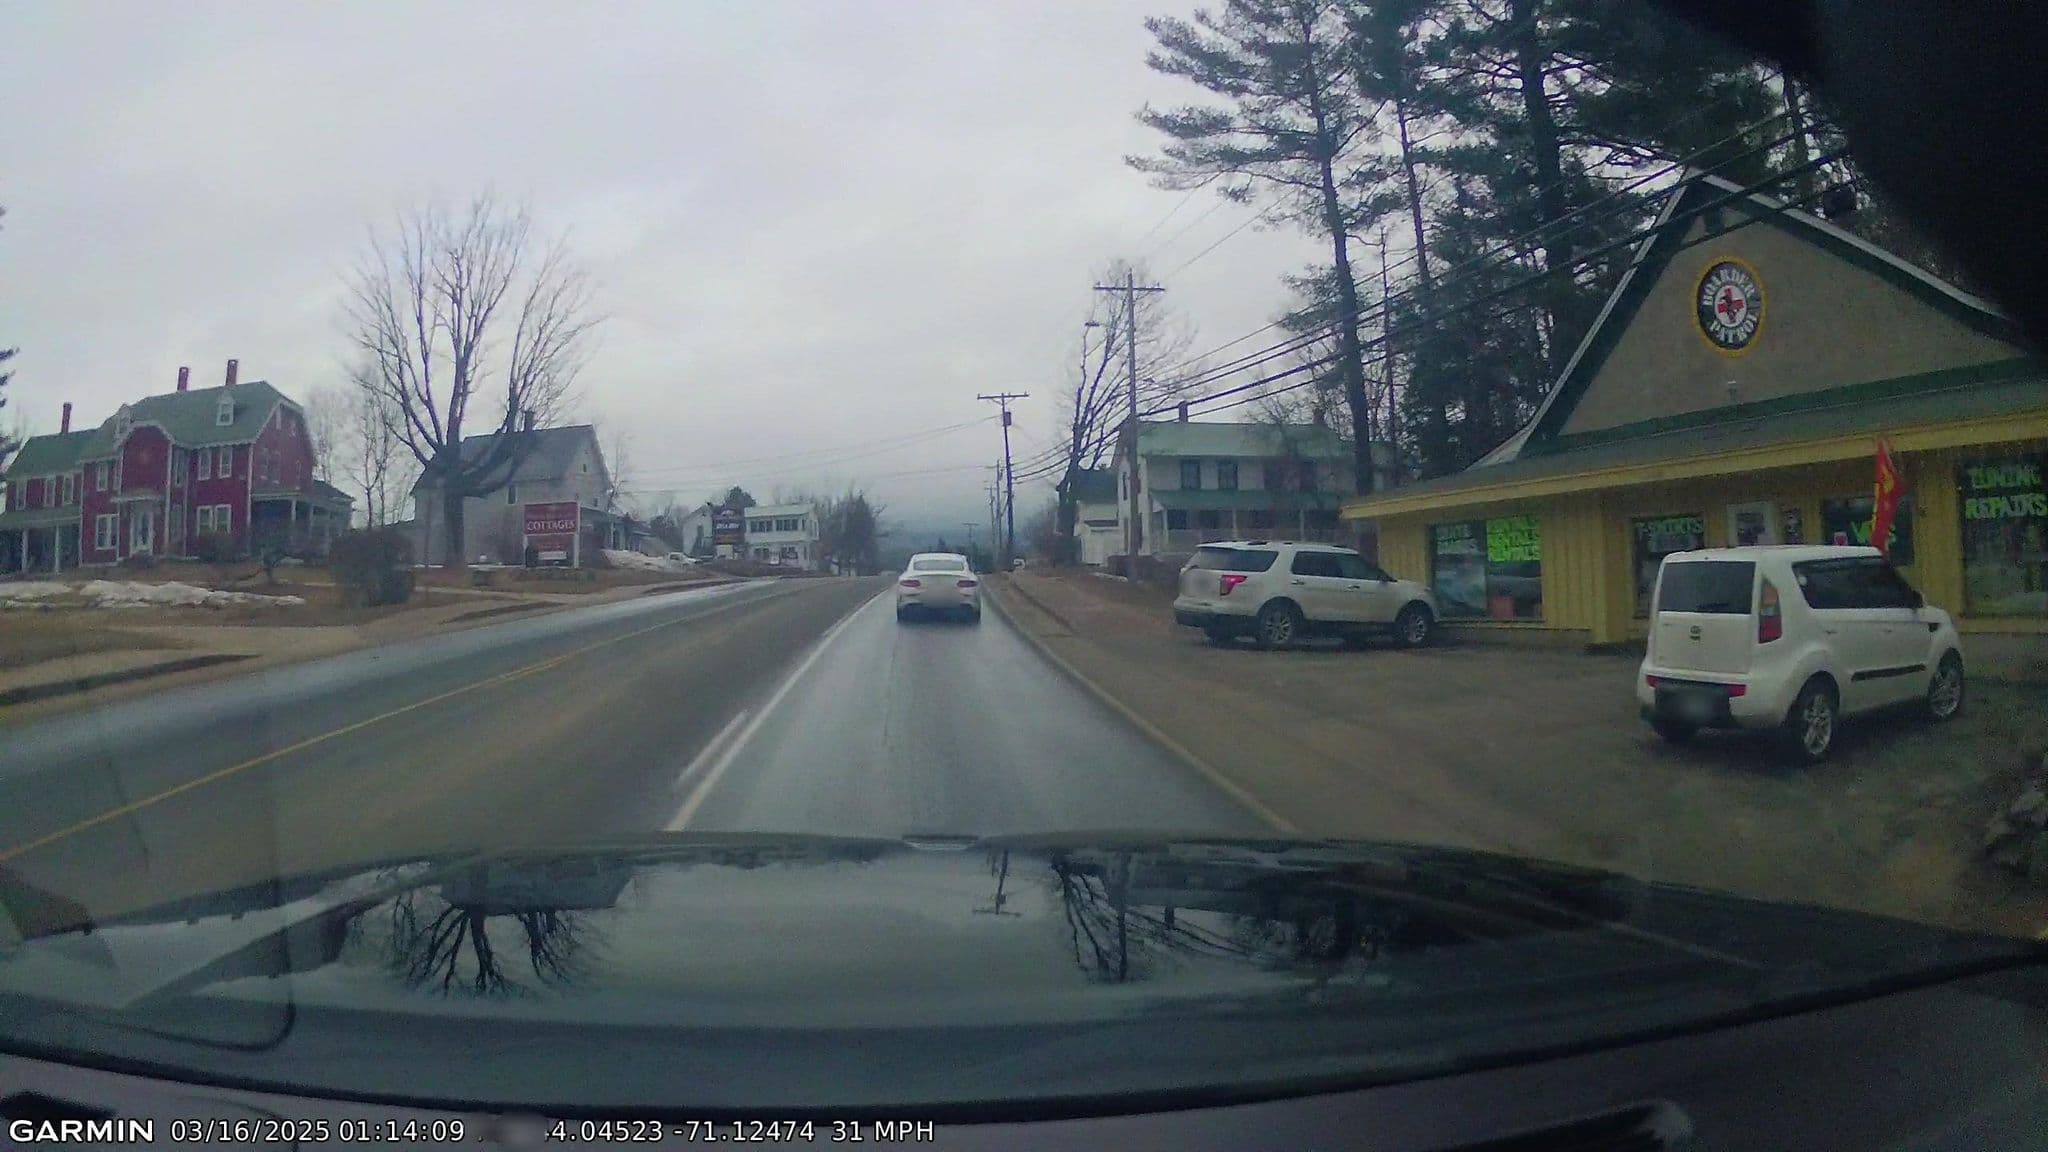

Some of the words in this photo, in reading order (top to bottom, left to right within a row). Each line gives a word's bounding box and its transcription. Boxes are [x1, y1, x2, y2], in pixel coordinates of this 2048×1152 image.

[1702, 269, 1755, 306] BOARDER
[1710, 313, 1757, 343] PATROL
[1965, 493, 2048, 519] REPAIRS
[527, 519, 576, 531] COTTAGES
